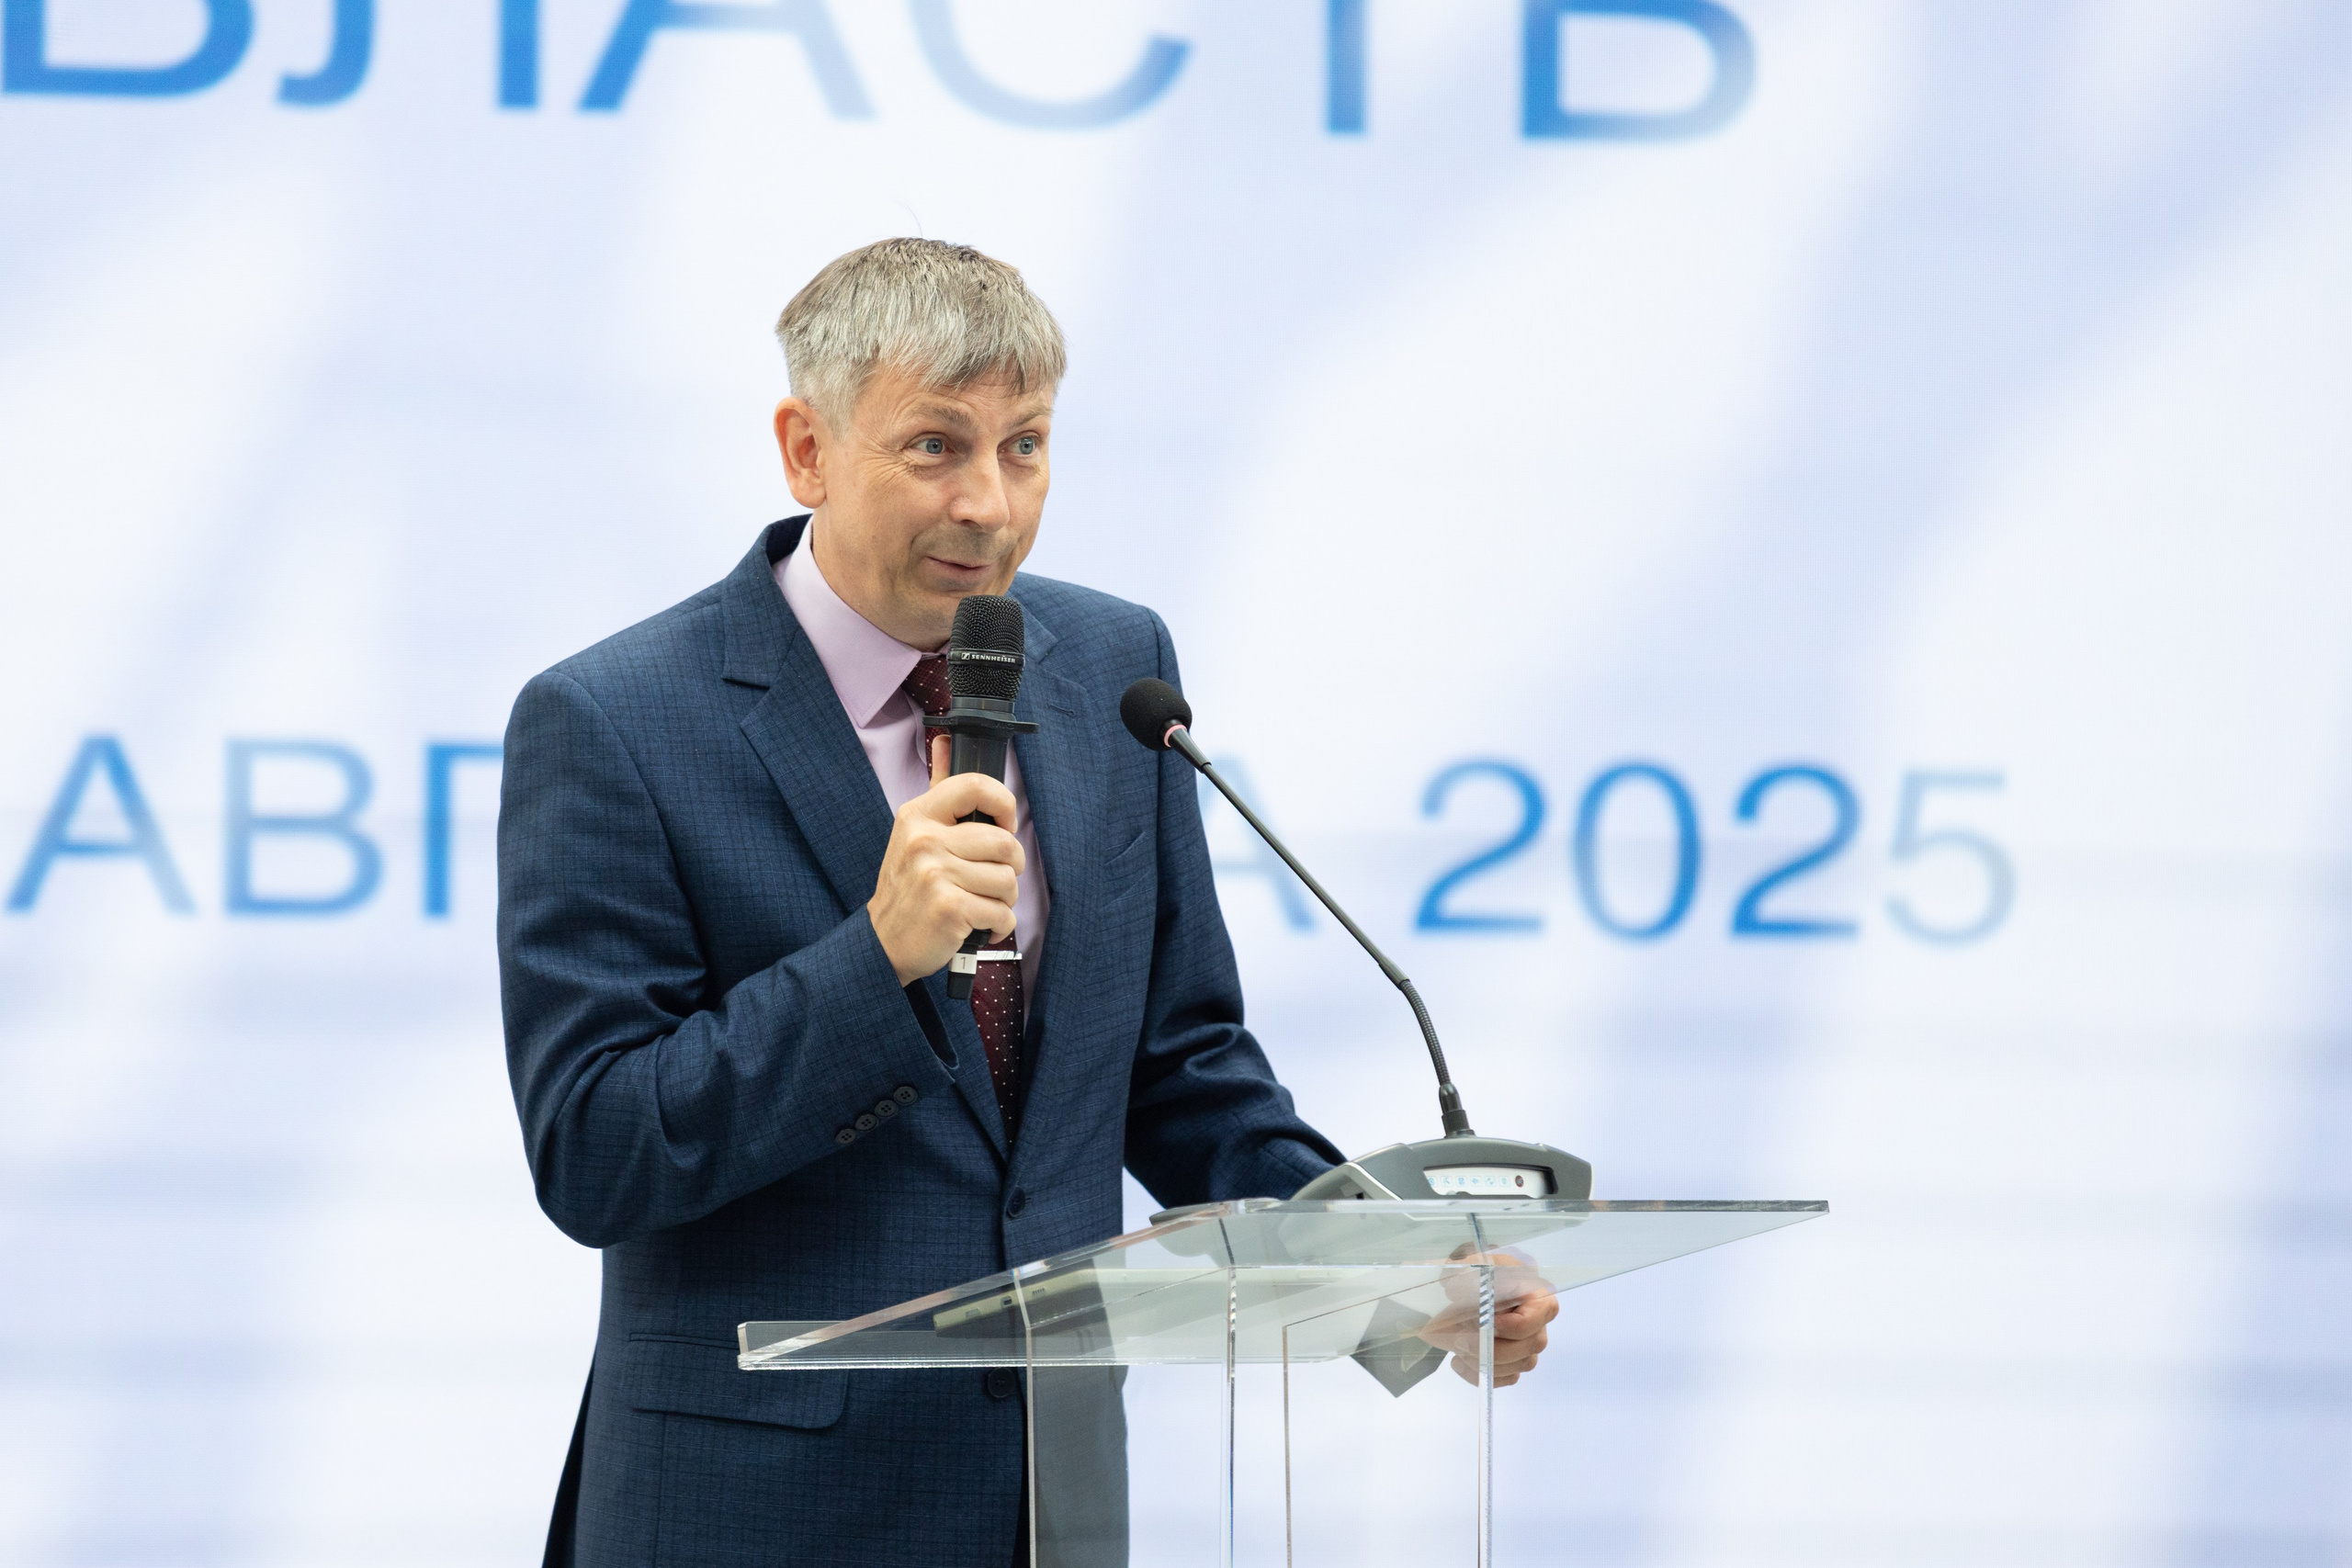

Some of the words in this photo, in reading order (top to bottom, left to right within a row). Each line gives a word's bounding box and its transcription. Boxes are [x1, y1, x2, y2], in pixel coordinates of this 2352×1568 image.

[971, 653, 1016, 663] SENNHEISER
[1413, 758, 2017, 945] 2025
[960, 956, 966, 970] 1
